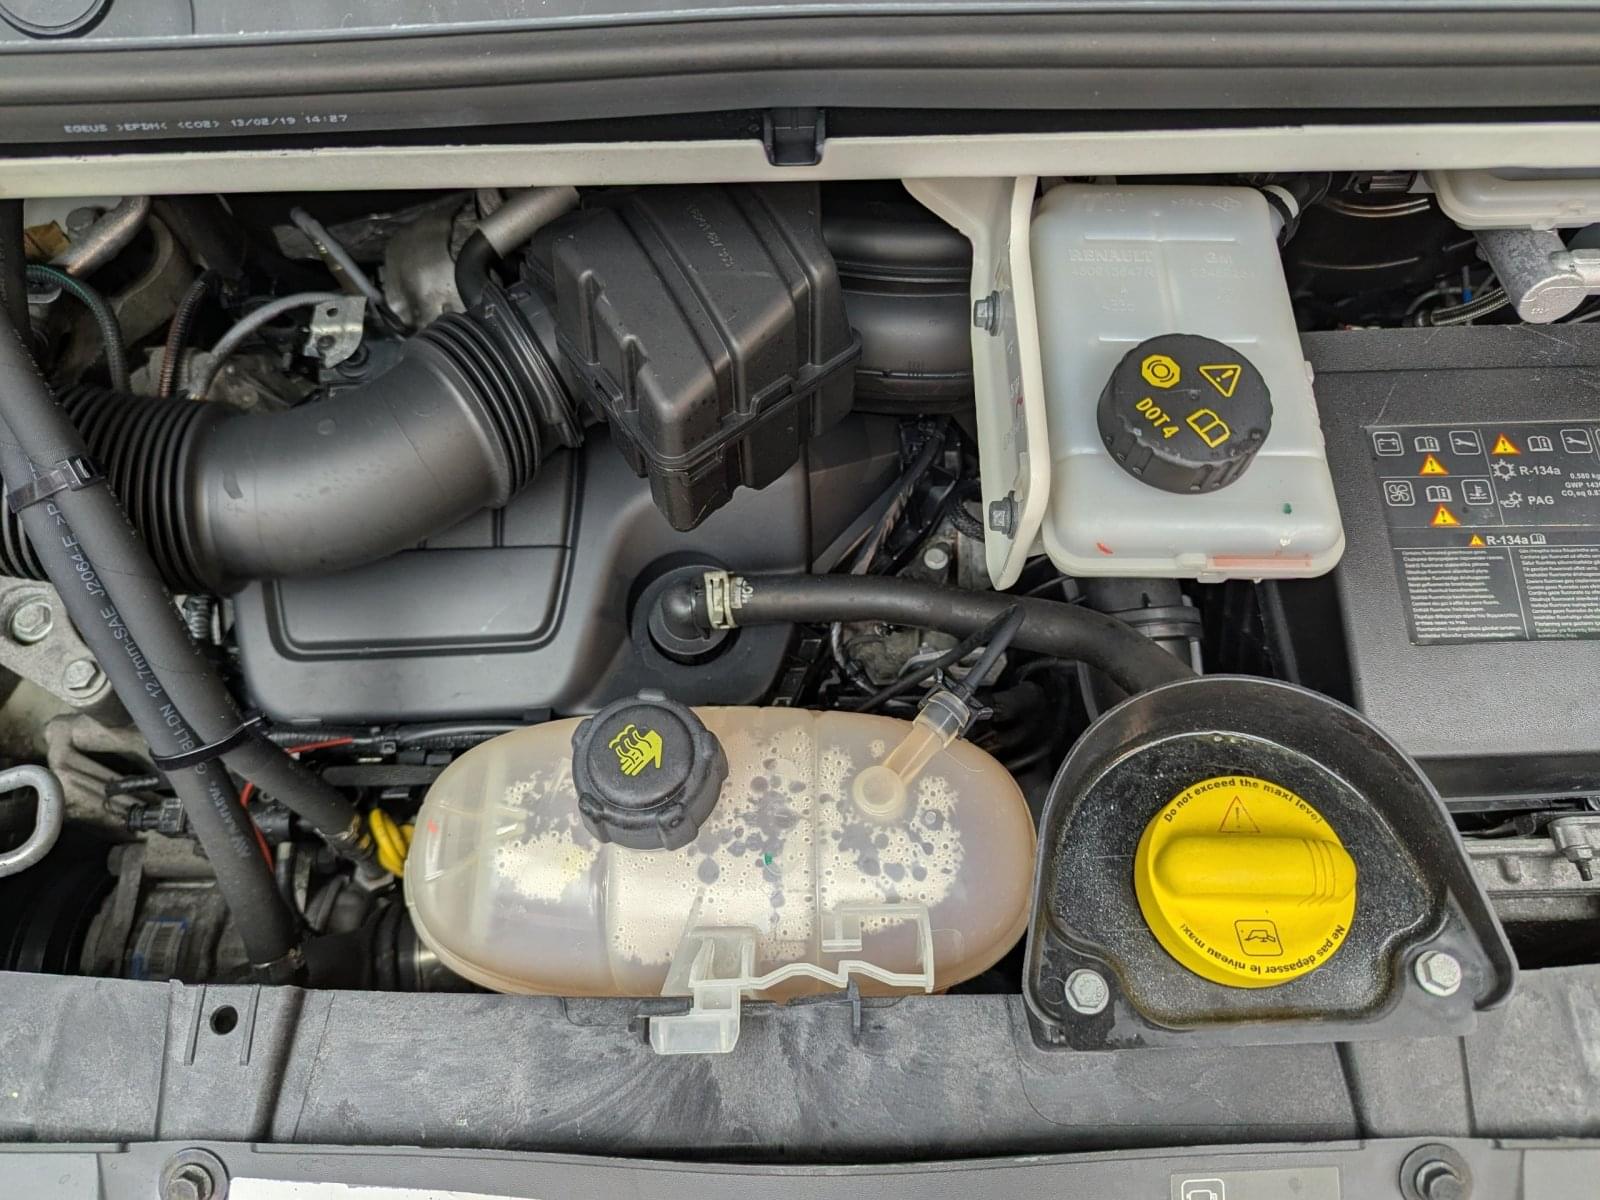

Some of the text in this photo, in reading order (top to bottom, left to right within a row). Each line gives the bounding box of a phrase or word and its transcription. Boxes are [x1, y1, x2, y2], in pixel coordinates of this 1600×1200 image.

[1519, 465, 1562, 476] R-134a
[1527, 495, 1555, 505] PAG
[1486, 535, 1529, 545] R-134a
[1164, 778, 1322, 824] Do not exceed the maxi level
[1180, 923, 1205, 949] maxi
[1332, 924, 1346, 940] Ne
[1316, 938, 1334, 957] pas
[1207, 947, 1246, 970] niveau
[1250, 964, 1261, 975] le
